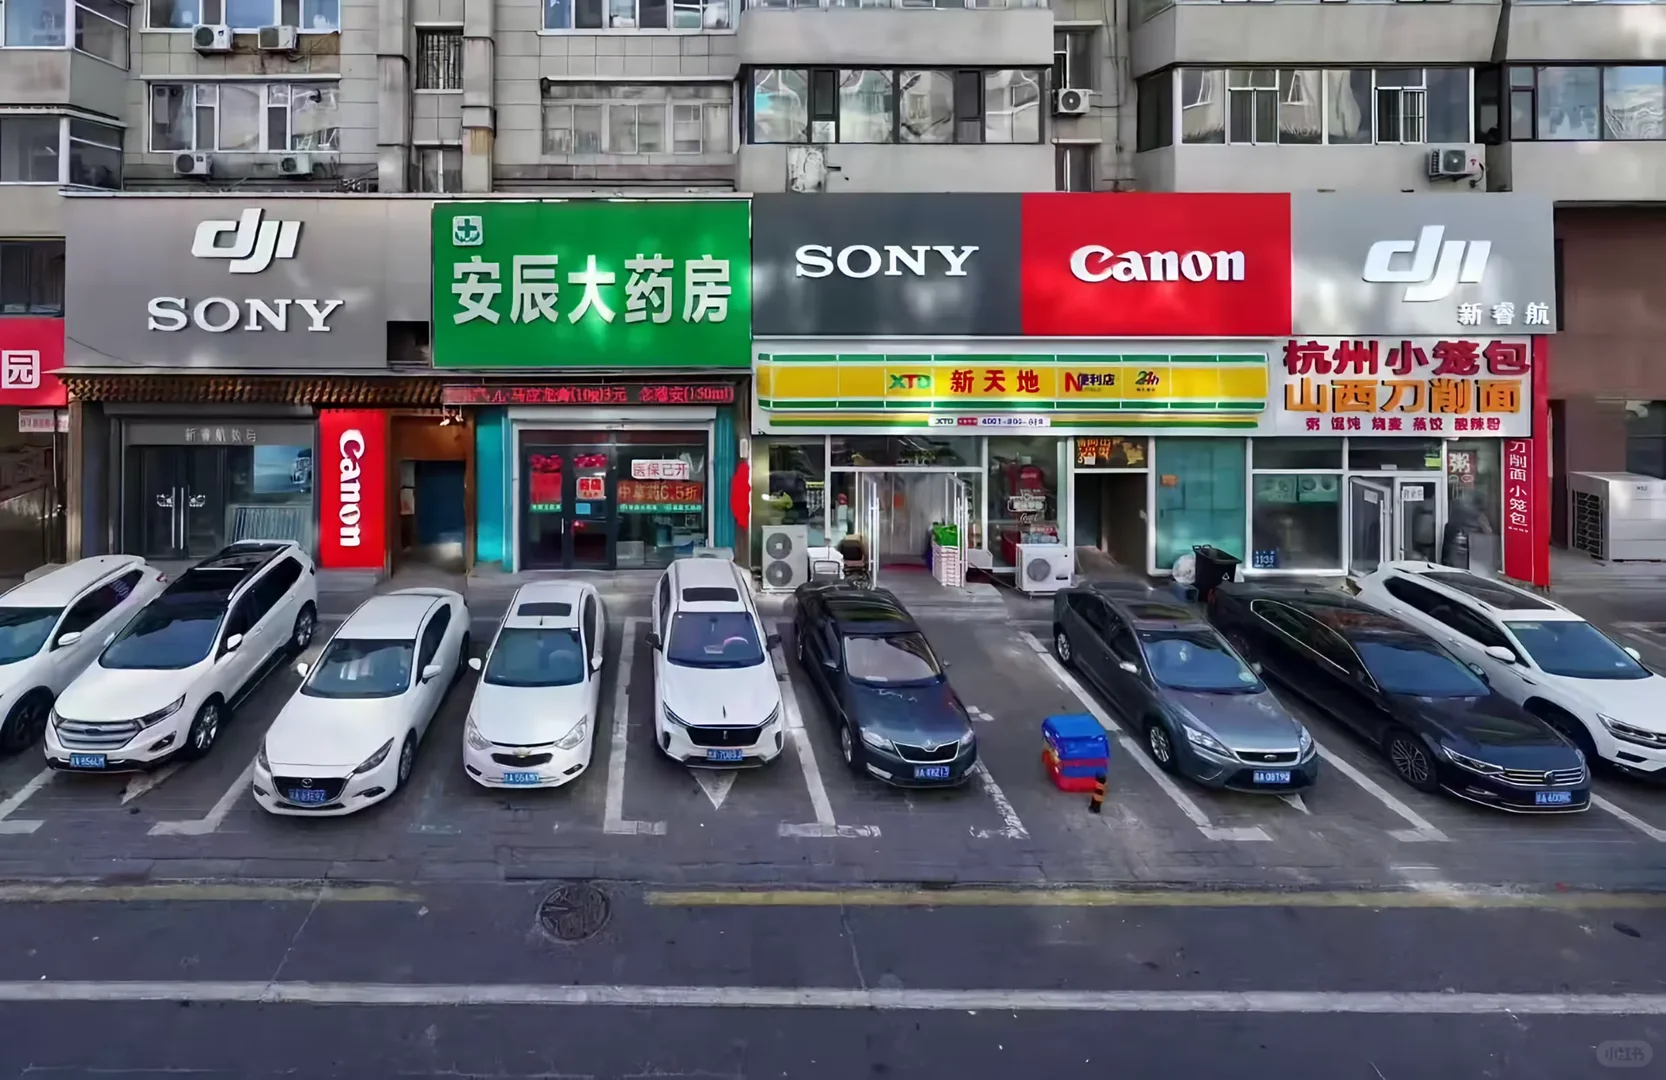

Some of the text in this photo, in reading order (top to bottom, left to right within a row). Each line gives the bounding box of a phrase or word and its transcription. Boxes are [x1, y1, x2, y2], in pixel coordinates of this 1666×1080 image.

[795, 244, 979, 278] SONY
[1069, 244, 1245, 282] Canon
[451, 253, 732, 324] 安辰大药房
[148, 297, 343, 332] SONY
[1457, 302, 1549, 325] 新睿航
[1, 350, 40, 389] 园
[1283, 340, 1530, 375] 杭州小笼包
[888, 374, 932, 389] XTD
[950, 369, 1040, 393] 新天地
[1284, 377, 1522, 413] 山西刀削面
[1306, 417, 1320, 431] 粥
[1331, 417, 1361, 431] 馄饨
[1413, 417, 1443, 431] 蒸饺
[1454, 417, 1500, 431] 酸辣粉
[1509, 441, 1527, 481] 刀削面
[339, 429, 365, 547] Canon
[1509, 485, 1528, 526] 小笼包
